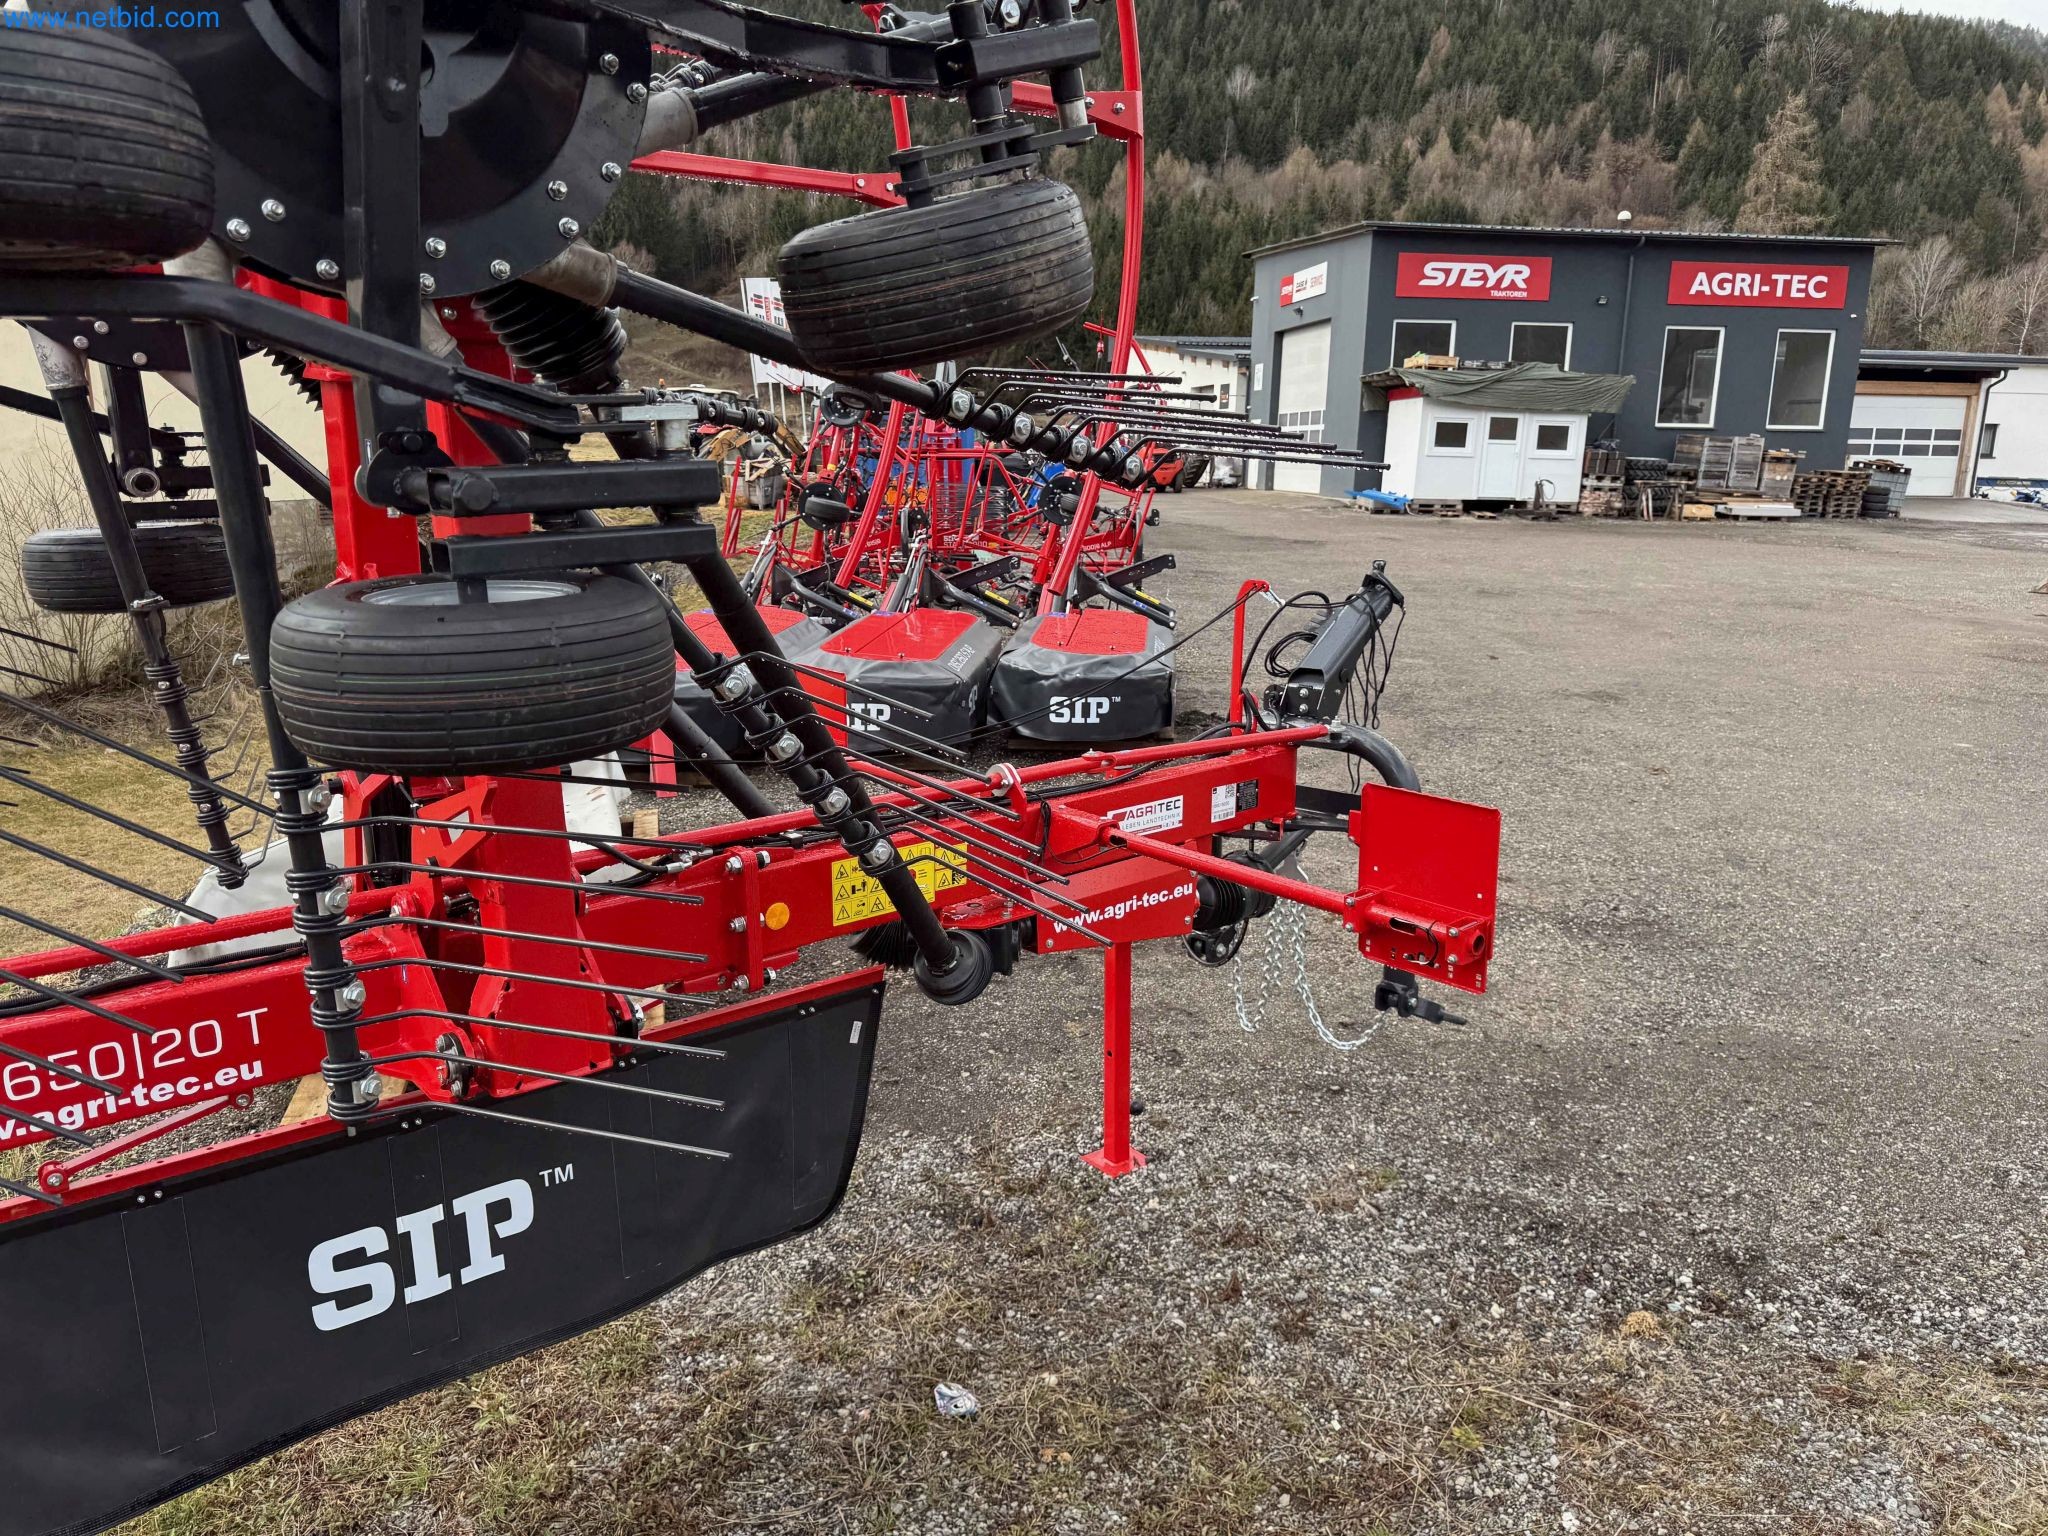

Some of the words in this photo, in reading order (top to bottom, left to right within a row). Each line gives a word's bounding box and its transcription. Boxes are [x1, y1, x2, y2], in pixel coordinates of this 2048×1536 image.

[1418, 262, 1531, 289] STEYR
[1689, 272, 1829, 299] AGRI-TEC
[1490, 290, 1528, 298] TRAKTOREN
[846, 703, 891, 731] IP
[1049, 696, 1110, 724] SIP
[1126, 799, 1181, 821] AGRITEC
[1053, 883, 1193, 934] www.agri-tec.eu
[236, 1007, 269, 1045] T
[308, 1179, 535, 1331] SIP
